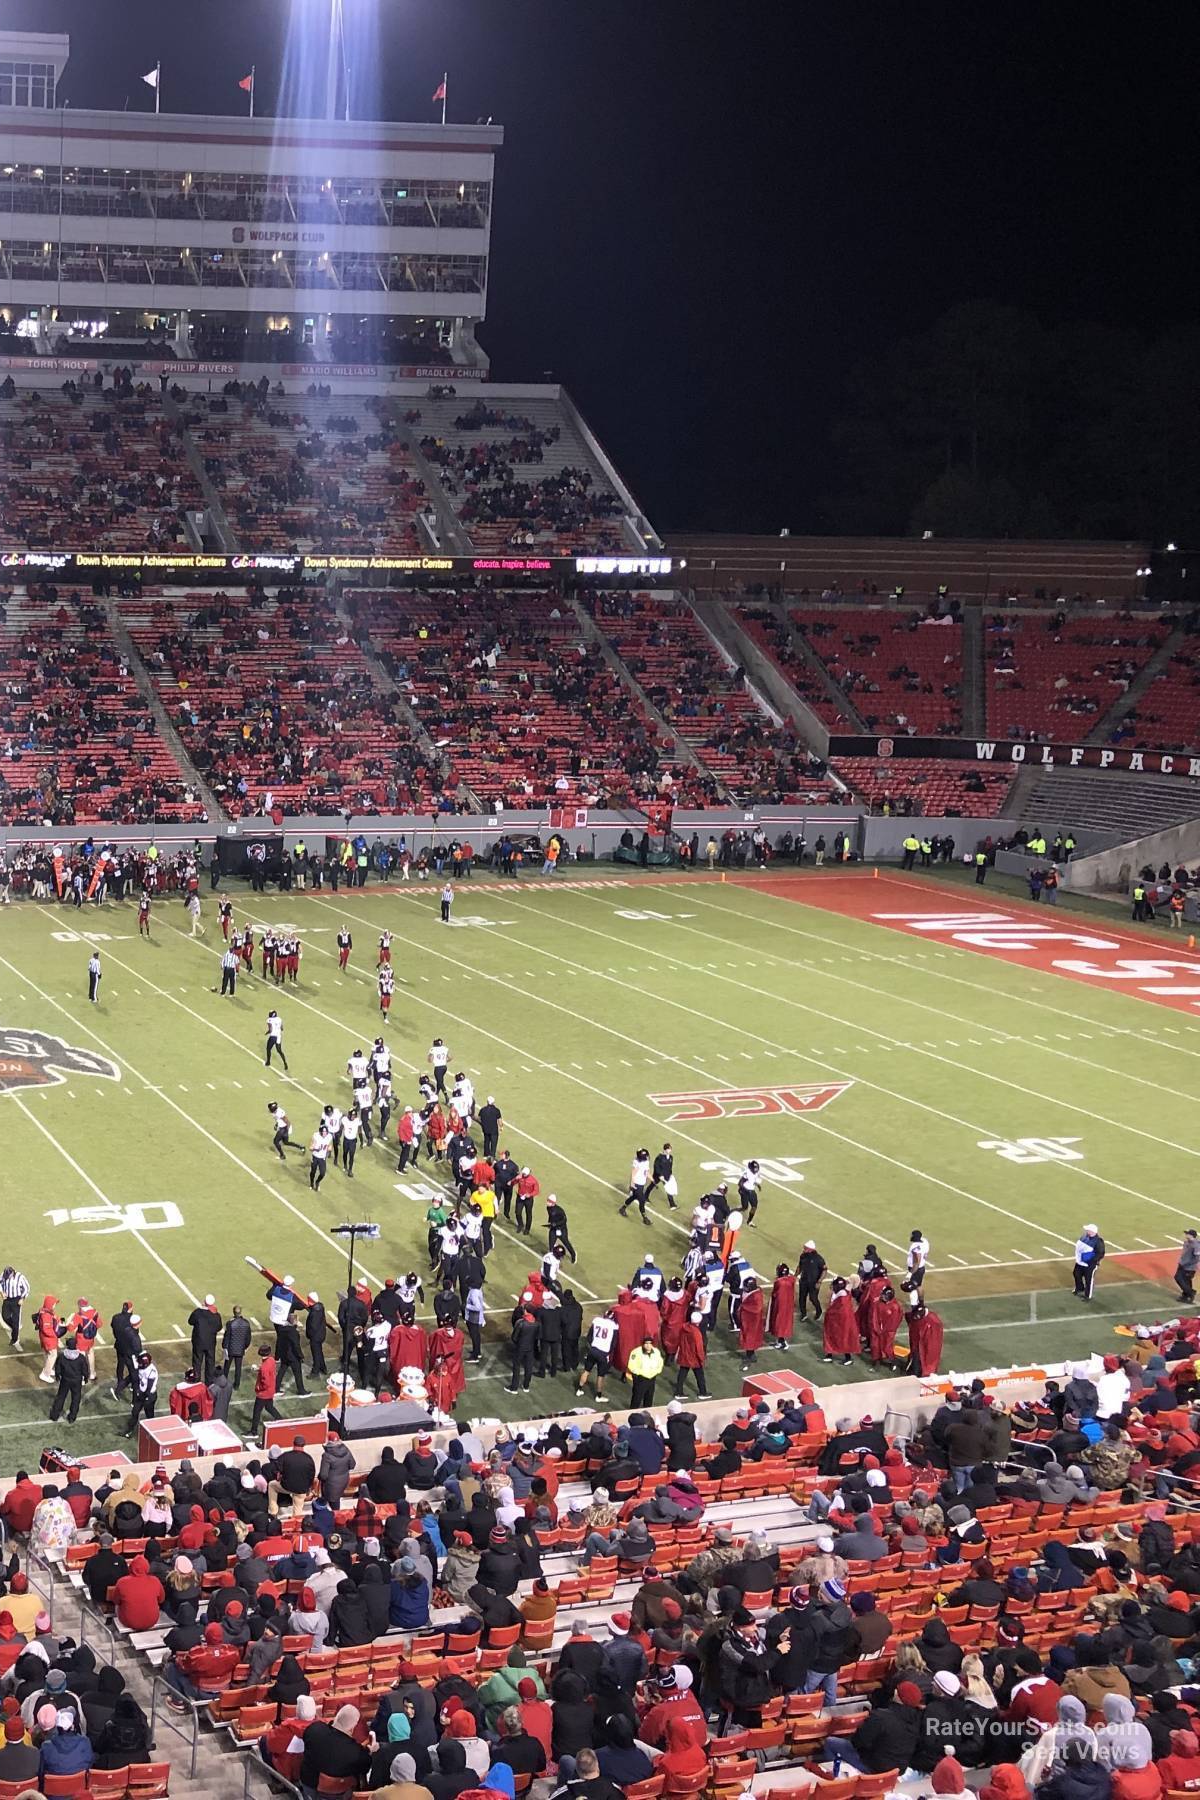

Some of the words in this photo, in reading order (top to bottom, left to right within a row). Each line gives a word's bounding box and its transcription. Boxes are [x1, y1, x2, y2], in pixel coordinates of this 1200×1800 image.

[250, 231, 298, 241] WOLFPACK
[302, 232, 325, 242] CLUB
[28, 360, 61, 370] TORRY
[64, 360, 89, 370] HOLT
[164, 363, 196, 374] PHILIP
[199, 363, 234, 374] RIVERS
[333, 367, 376, 377] WILLIAMS
[416, 368, 455, 378] BRADLEY
[460, 370, 487, 379] CHUBB
[77, 554, 99, 565] Down
[102, 555, 140, 567] Syndrome
[143, 555, 194, 567] Achievement
[196, 556, 226, 567] Centers
[304, 556, 328, 568] Down
[329, 557, 368, 570] Syndrome
[370, 557, 421, 569] Achievement
[422, 558, 452, 569] Centers
[976, 742, 1200, 776] WOLFPACK
[614, 910, 672, 920] 10
[871, 912, 1120, 949] NC
[647, 1081, 856, 1122] ACC
[977, 1137, 1085, 1164] 20
